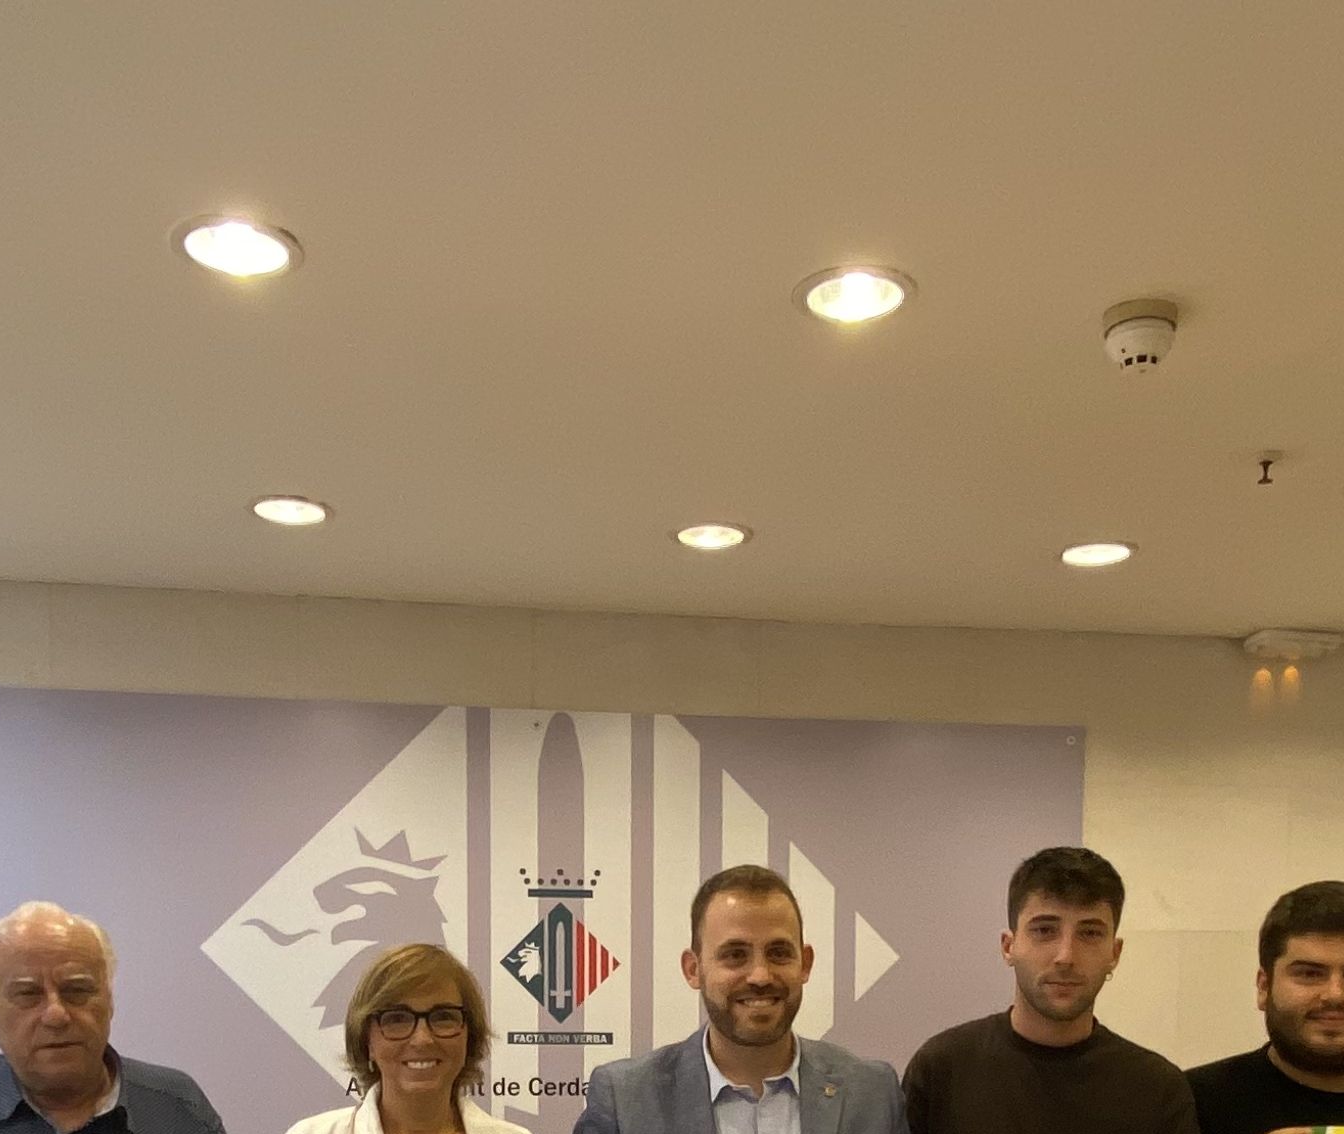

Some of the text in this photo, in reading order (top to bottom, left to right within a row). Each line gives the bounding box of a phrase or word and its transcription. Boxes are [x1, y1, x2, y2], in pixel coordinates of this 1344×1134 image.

[513, 1034, 607, 1043] FACTA NON VERBA
[493, 1078, 521, 1096] de
